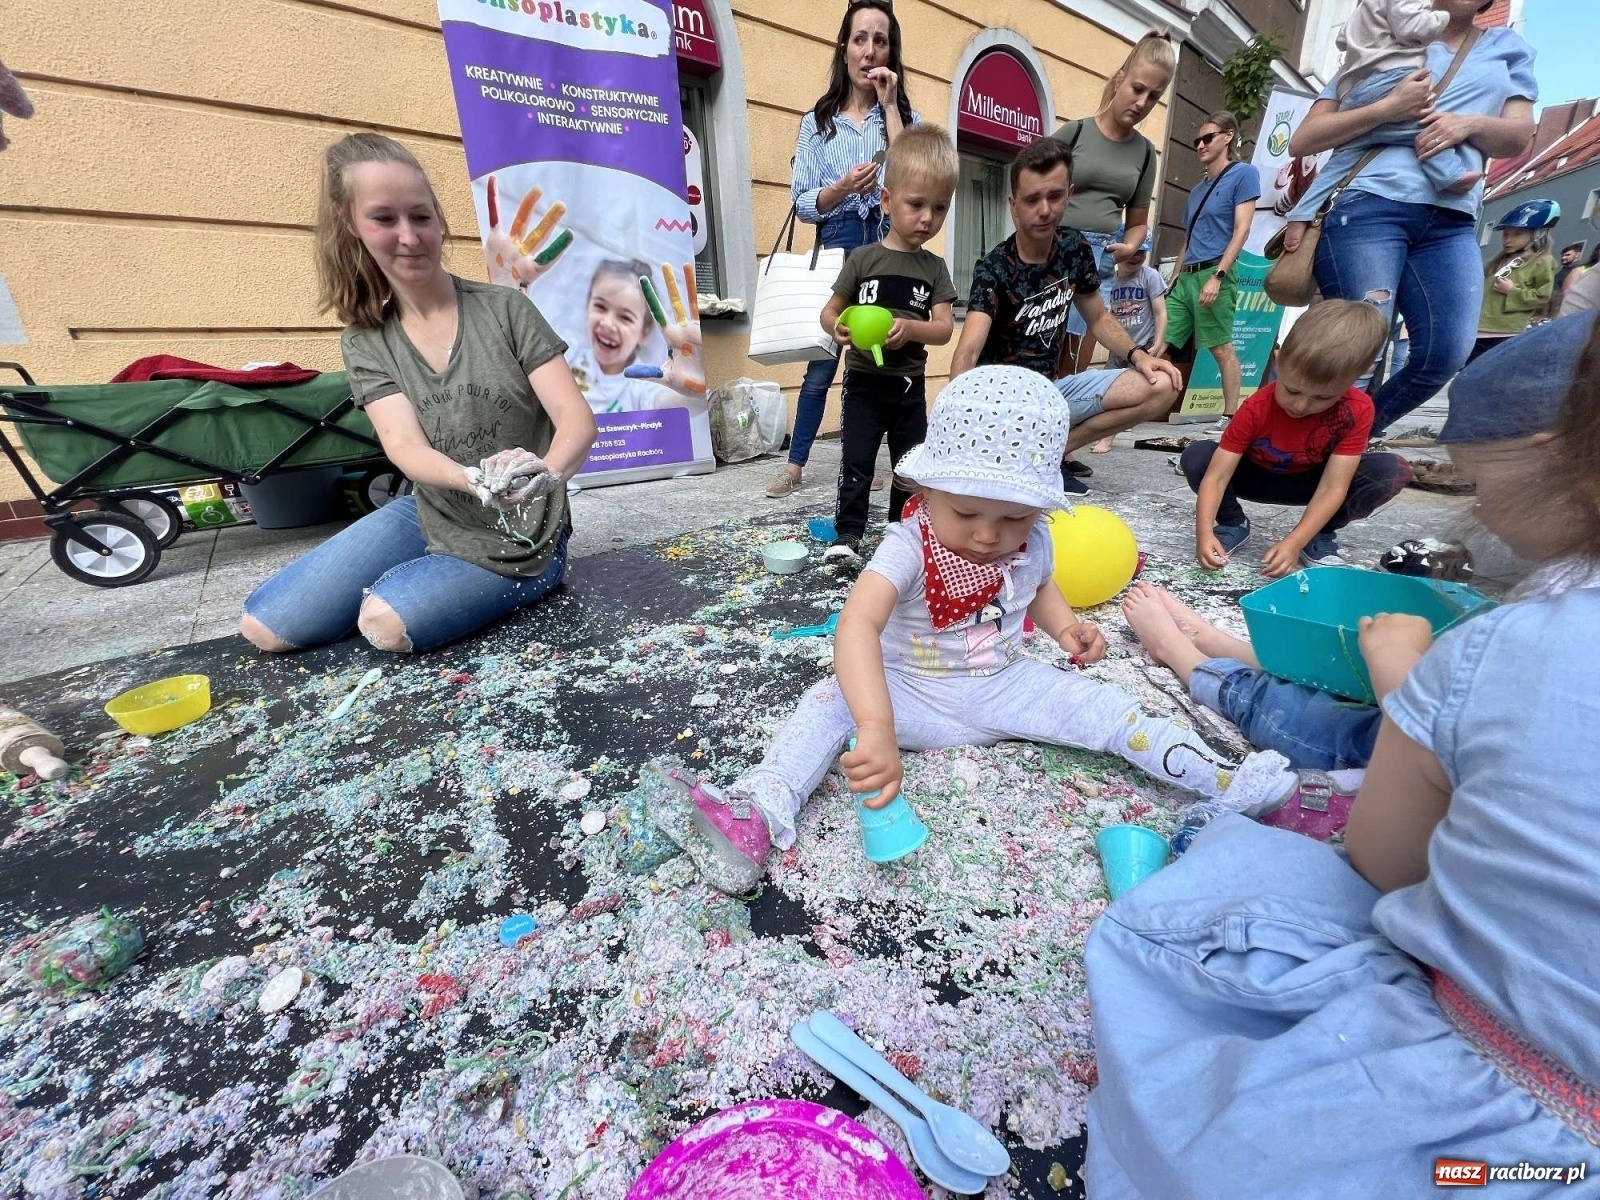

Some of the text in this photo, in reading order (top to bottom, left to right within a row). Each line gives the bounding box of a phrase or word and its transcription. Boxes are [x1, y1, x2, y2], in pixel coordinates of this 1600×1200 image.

[465, 65, 660, 108] KREATYWNIE KONSTRUKTYWNIE
[481, 86, 669, 125] POLIKOLOROWO SENSORYCZNIE
[967, 84, 1040, 133] Millennium
[537, 112, 623, 135] INTERAKTYWNIE
[1017, 129, 1033, 144] bank
[858, 279, 880, 305] 03
[1014, 288, 1074, 322] Paradise
[1025, 304, 1068, 336] Island
[1119, 315, 1143, 328] CIAL
[416, 383, 512, 415] AMOUR POUR TOI
[432, 416, 502, 453] Amour
